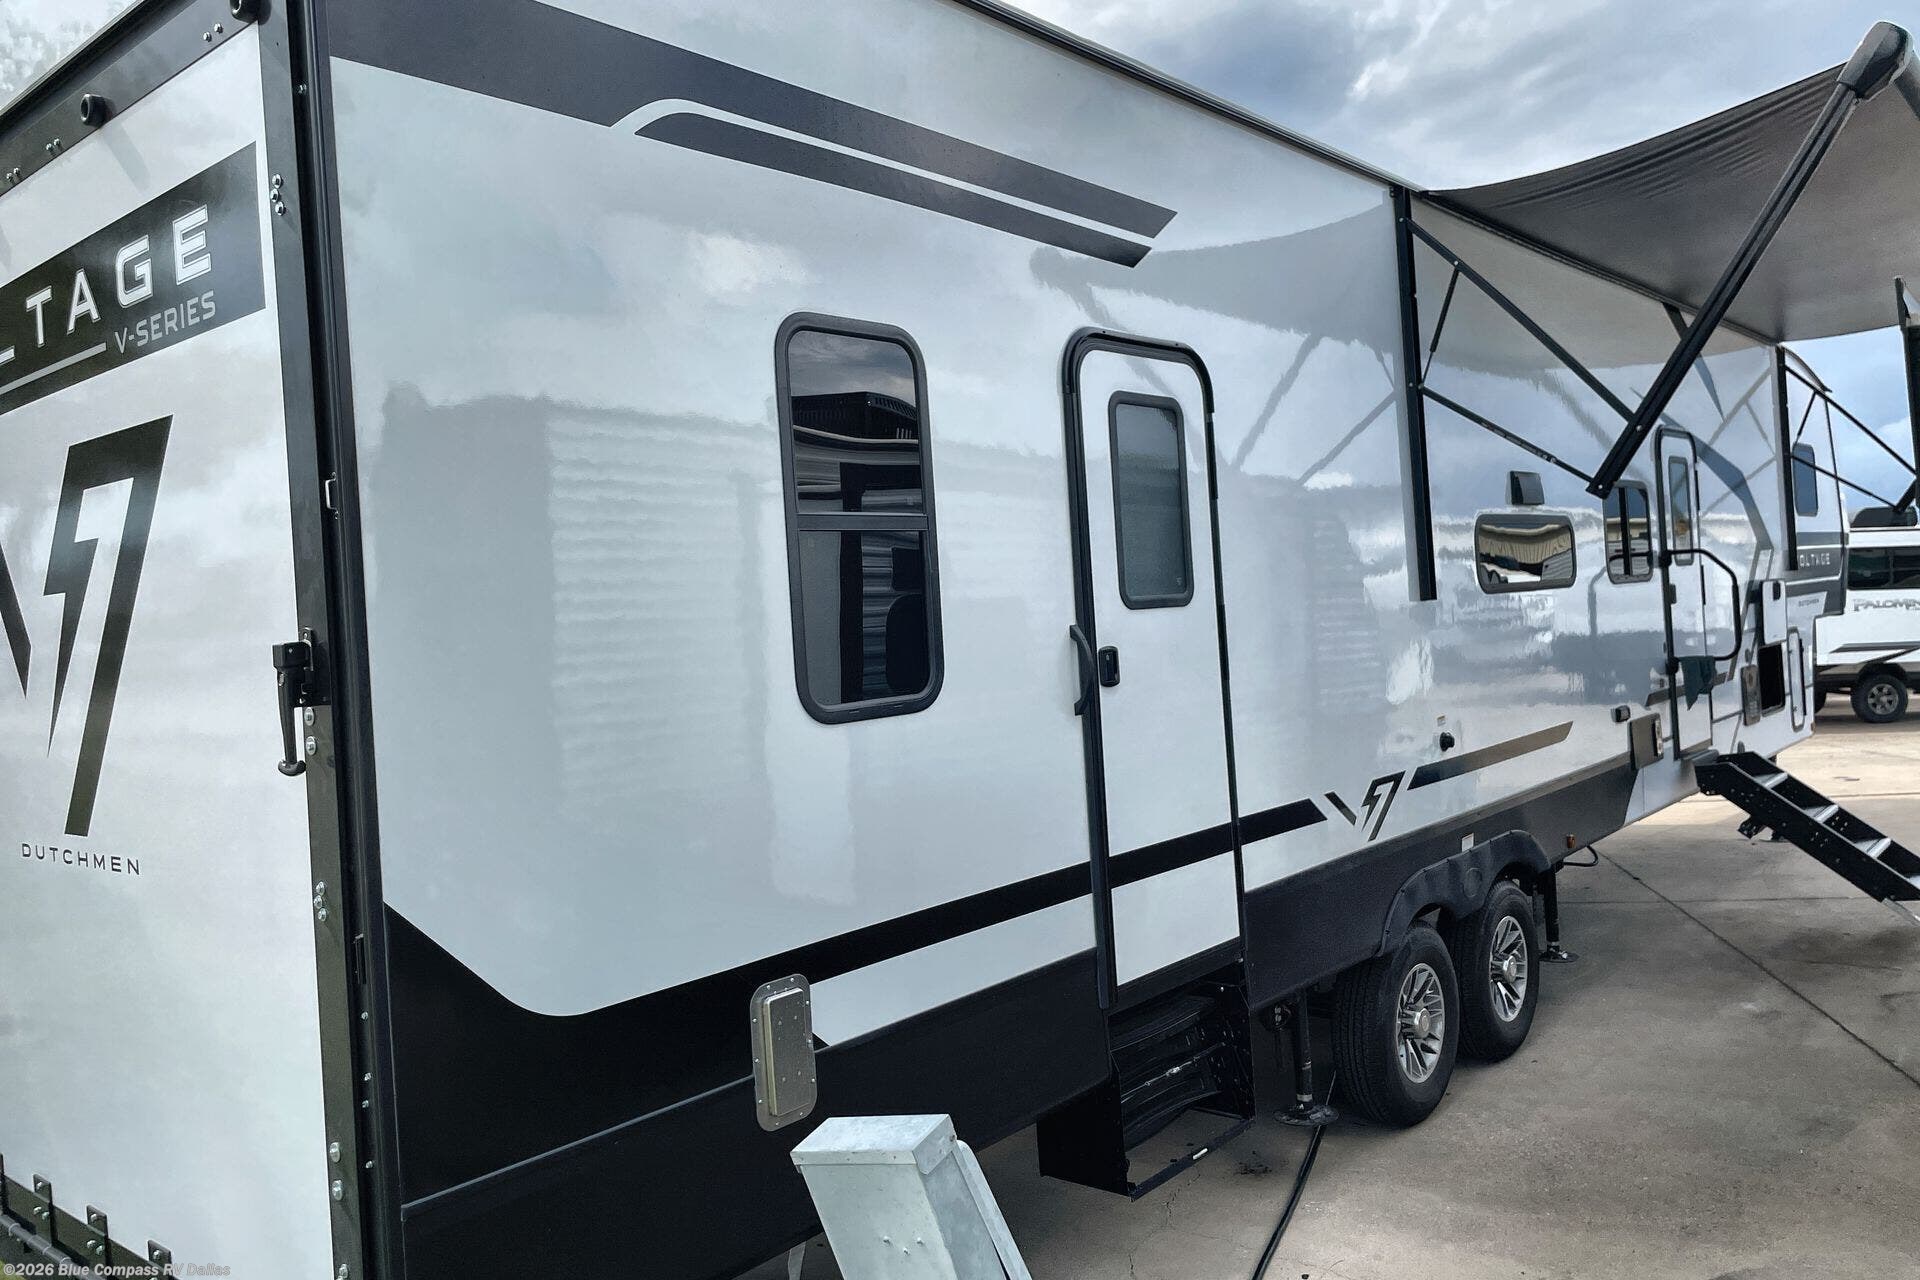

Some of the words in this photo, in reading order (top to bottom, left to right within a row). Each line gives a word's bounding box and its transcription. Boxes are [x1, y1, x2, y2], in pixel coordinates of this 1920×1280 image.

[0, 204, 212, 366] TAGE
[114, 290, 216, 354] V-SERIES
[1799, 552, 1831, 567] OLTAGE
[21, 843, 141, 876] DUTCHMEN
